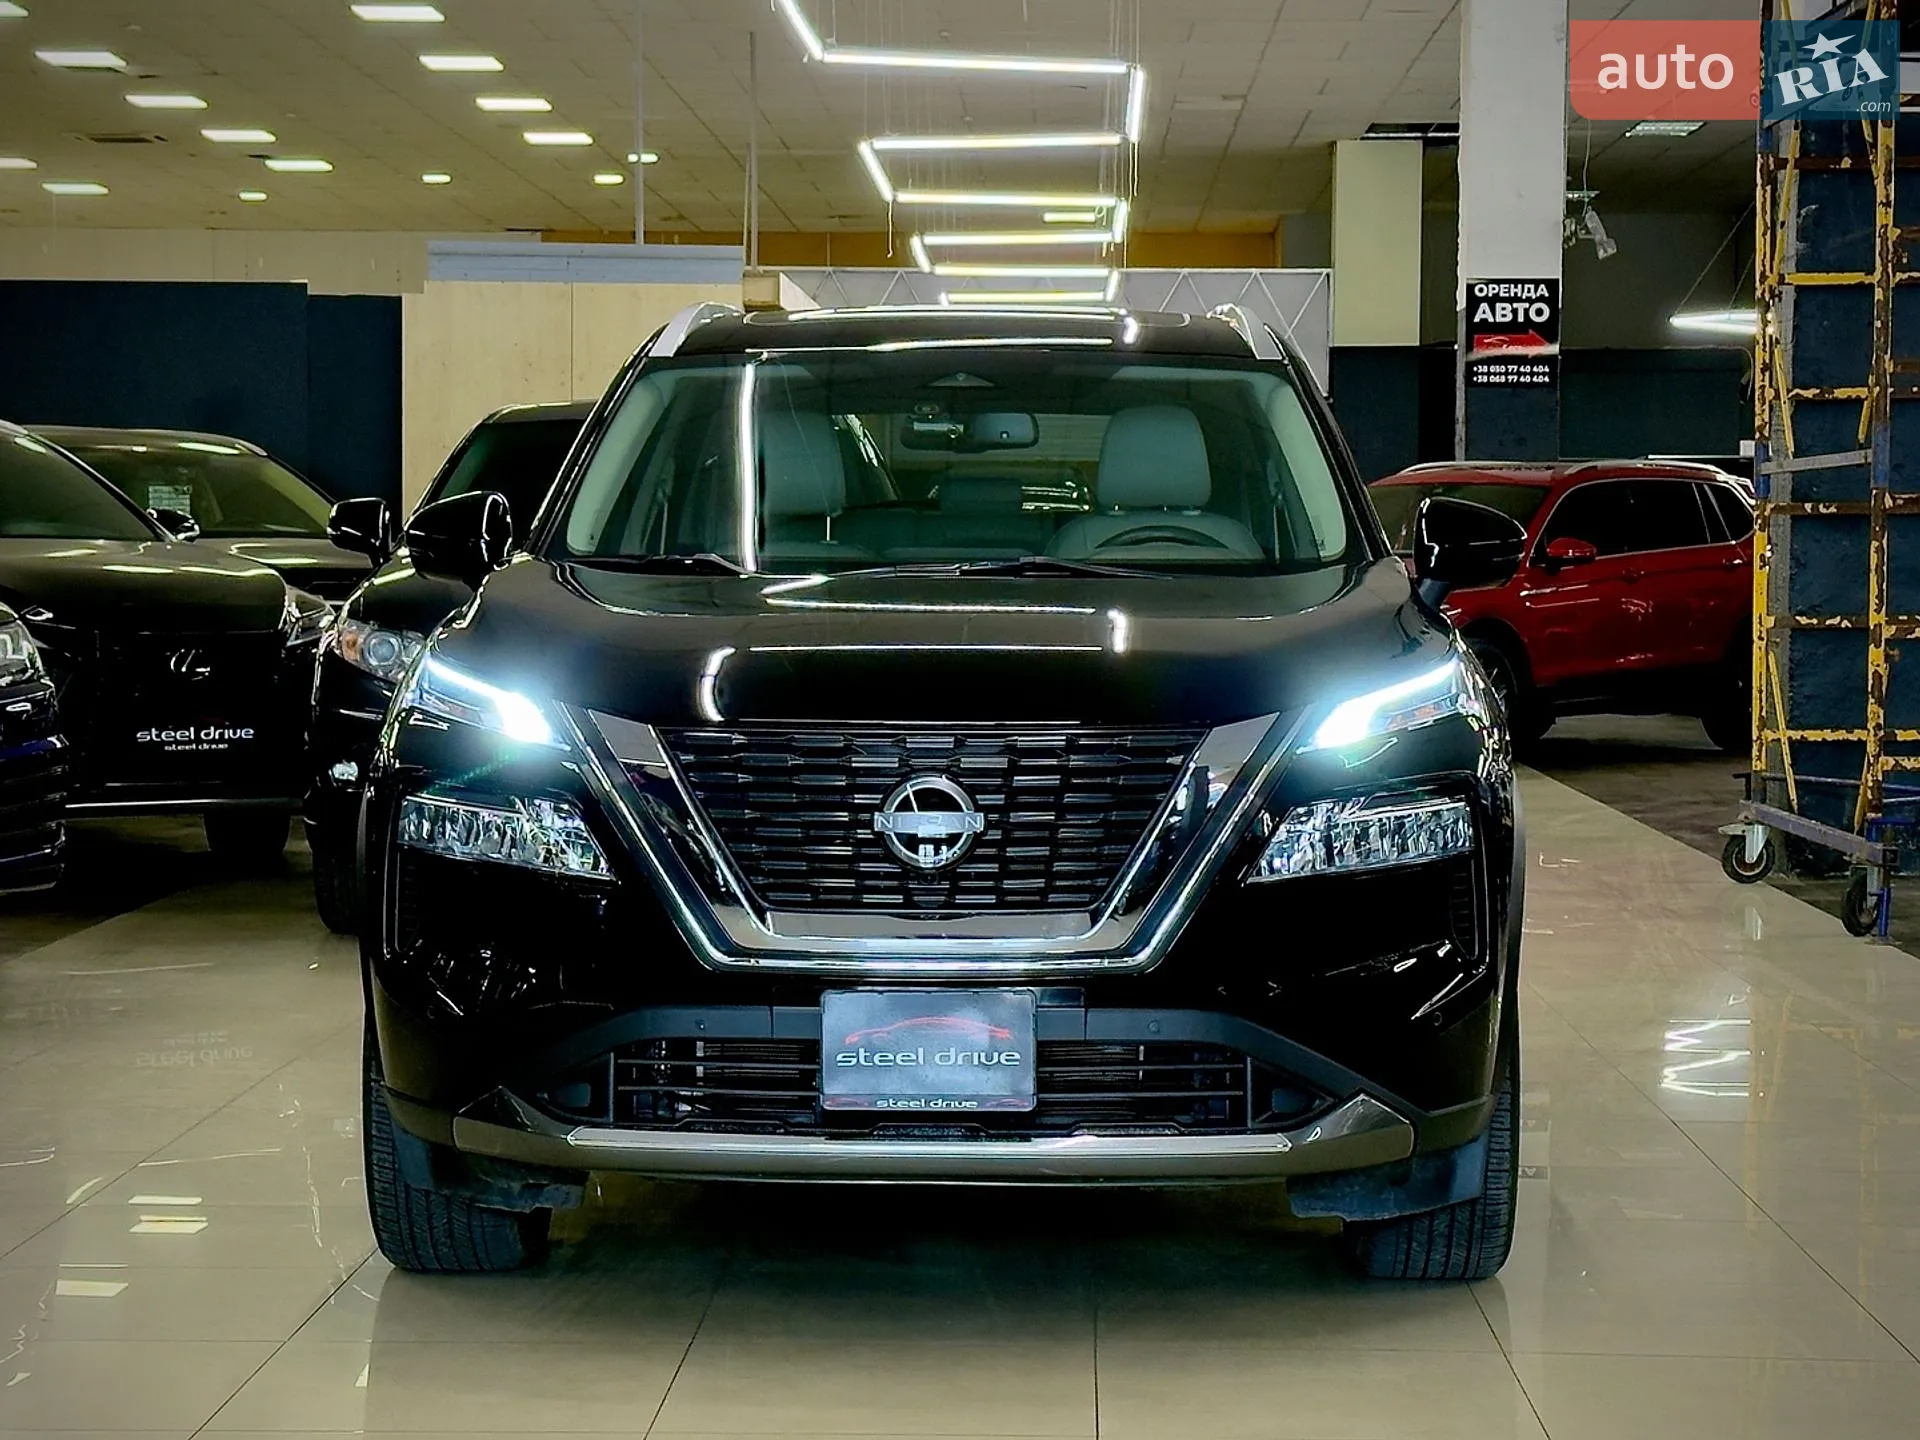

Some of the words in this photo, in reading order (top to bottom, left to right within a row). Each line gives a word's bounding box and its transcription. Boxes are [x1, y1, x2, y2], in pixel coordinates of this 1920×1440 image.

[1474, 284, 1549, 299] ОРЕНДА
[1473, 302, 1550, 323] АВТО
[1507, 365, 1518, 373] 77
[1519, 365, 1531, 373] 40
[1532, 365, 1549, 373] 404
[1507, 375, 1518, 383] 77
[1519, 375, 1531, 383] 40
[1532, 375, 1549, 383] 404
[136, 727, 195, 742] steel
[200, 726, 254, 740] drive
[836, 1048, 924, 1067] steel
[934, 1048, 1021, 1066] drive
[876, 1098, 925, 1108] steel
[929, 1098, 978, 1108] drive
